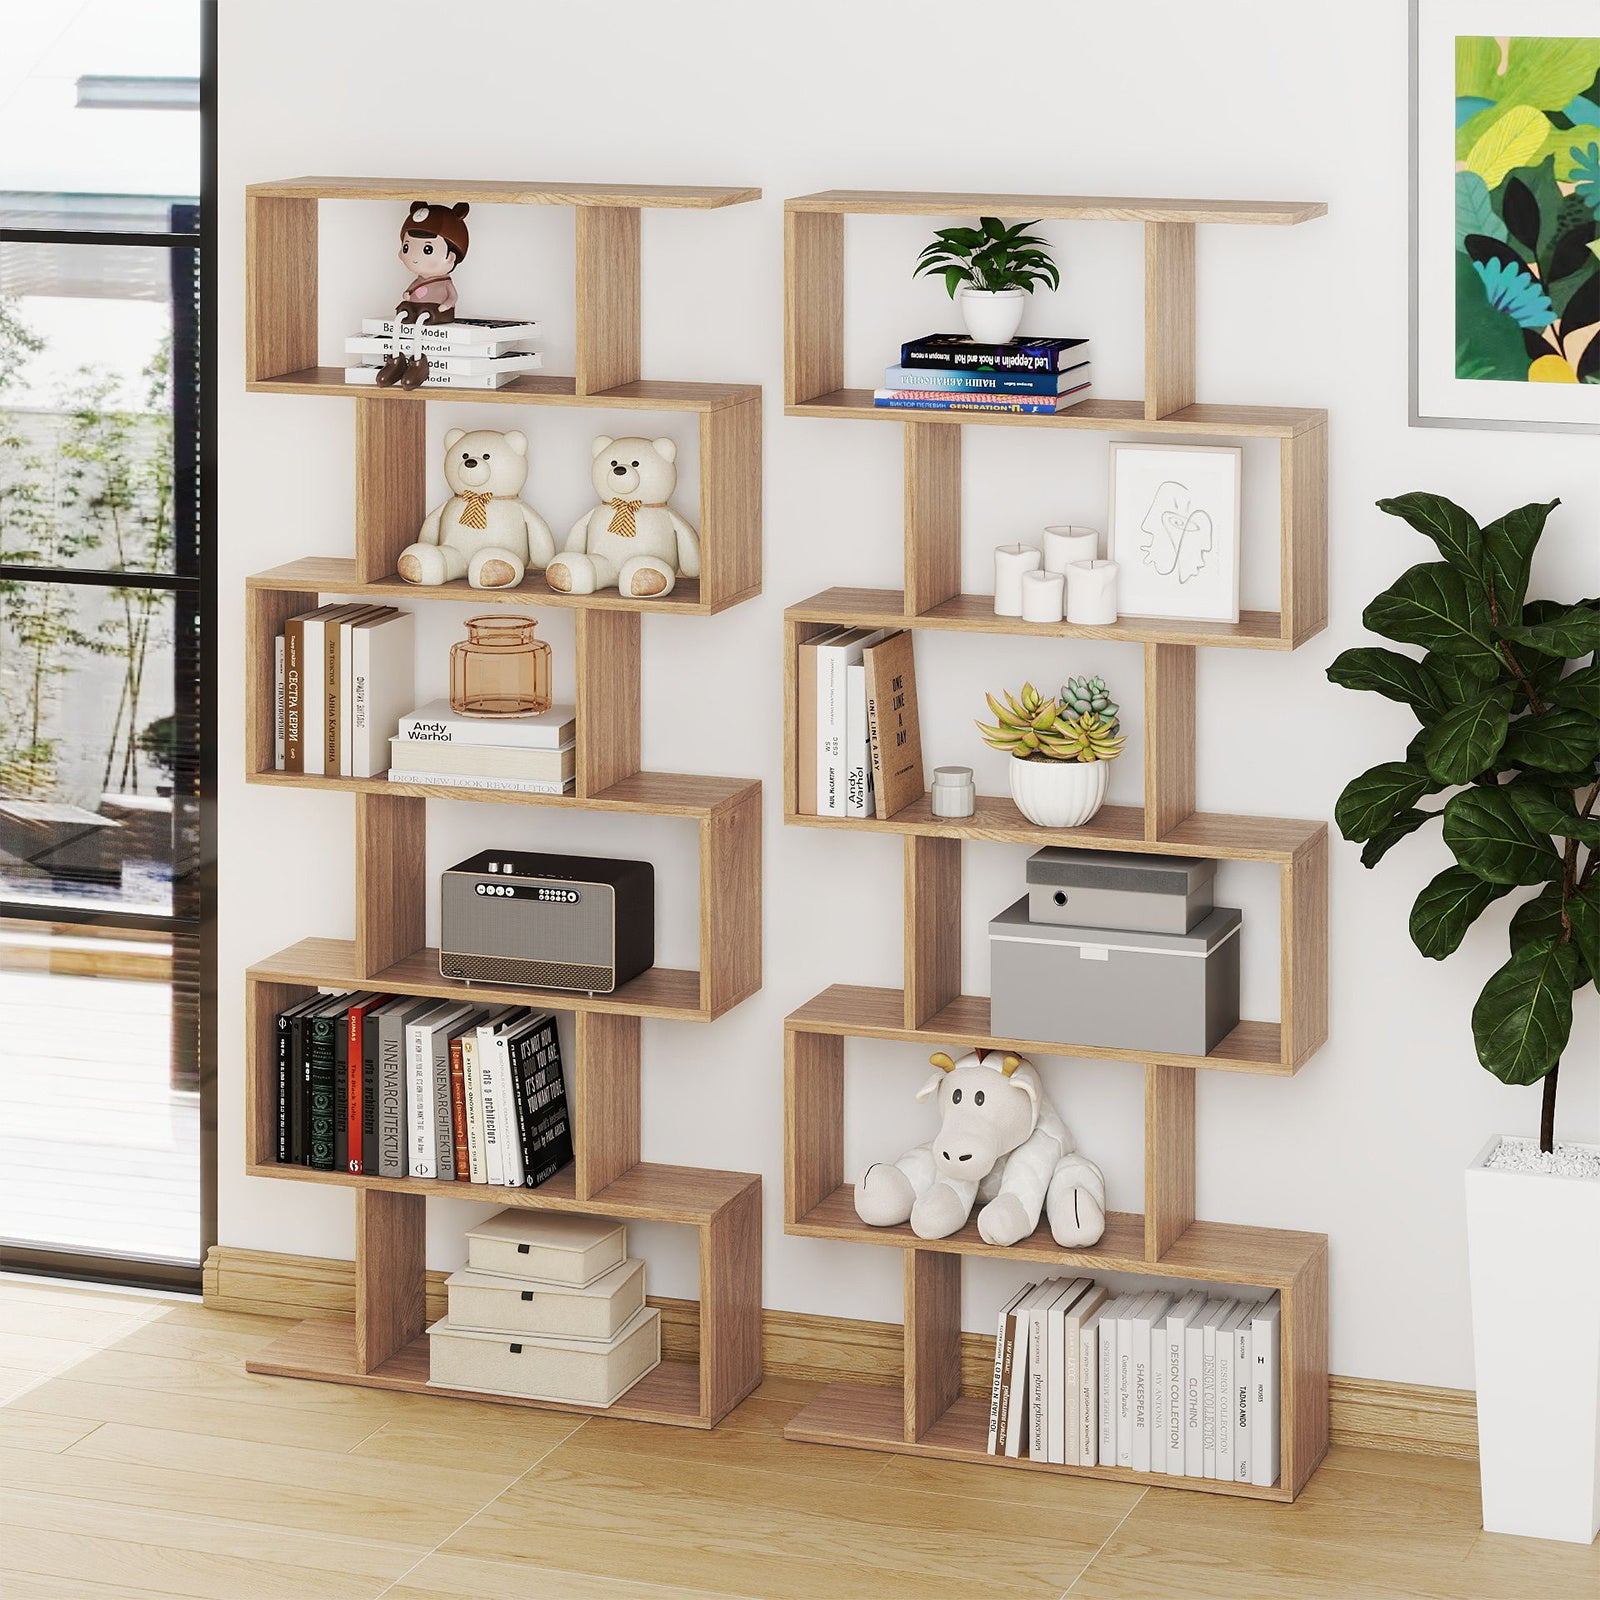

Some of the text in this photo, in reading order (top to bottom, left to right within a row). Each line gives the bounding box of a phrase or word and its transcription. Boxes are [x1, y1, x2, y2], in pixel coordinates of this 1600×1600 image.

[383, 322, 414, 335] Balor
[427, 359, 448, 370] odel
[954, 354, 966, 364] Roll
[967, 354, 978, 364] and
[979, 355, 994, 365] Rock
[1002, 353, 1033, 369] Zeppelin
[1034, 357, 1049, 370] Led
[965, 378, 996, 388] НАШИ
[949, 403, 1008, 411] GENERATION
[893, 675, 905, 692] ONE
[288, 670, 299, 742] СЕСТРА КЕРРИ
[868, 699, 876, 718] ONE
[892, 693, 905, 711] LINE
[408, 731, 452, 741] Warhol
[413, 722, 447, 734] Andy
[896, 730, 907, 747] DAY
[425, 777, 450, 785] NEW
[453, 779, 483, 787] LOOK
[487, 781, 558, 793] REVOLUTION
[848, 771, 856, 803] Andy
[855, 766, 864, 809] Warhol
[482, 1069, 493, 1085] arts
[364, 1087, 376, 1135] architecture
[383, 1039, 399, 1168] INNENARCHITEKTUR
[435, 1055, 452, 1171] INNENARCHITEKTUR
[484, 1097, 496, 1145] architecture
[1137, 1363, 1145, 1428] SHAKESPEARE
[1170, 1344, 1179, 1449] DESIGN COLLECTION
[1189, 1377, 1198, 1428] CLOTHING
[1204, 1355, 1214, 1450] DESIGN COLLECTION
[1220, 1359, 1228, 1454] DESIGN COLLECTION
[1239, 1386, 1247, 1428] TADAO ANDO
